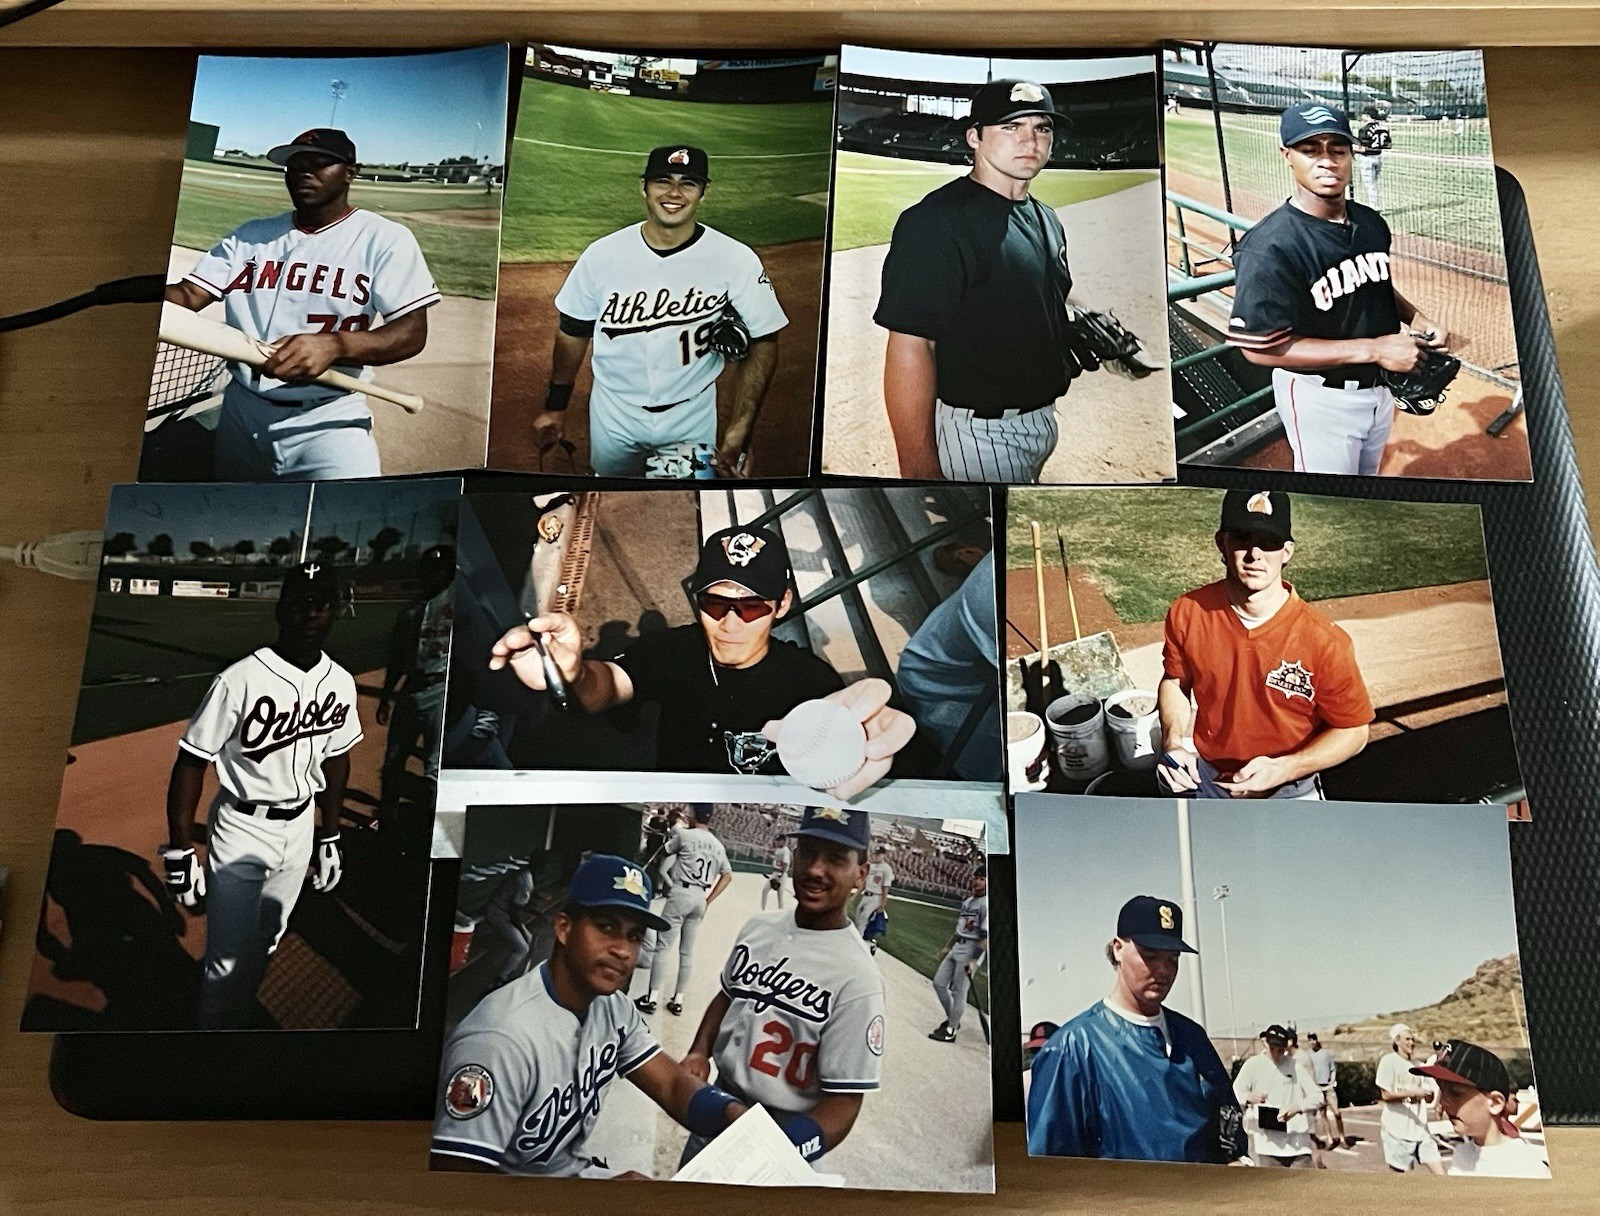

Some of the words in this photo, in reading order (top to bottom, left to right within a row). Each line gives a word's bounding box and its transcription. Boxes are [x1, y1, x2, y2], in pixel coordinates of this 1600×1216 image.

[222, 255, 371, 306] ANGELS
[240, 690, 351, 749] Orioles
[691, 857, 712, 882] 31
[730, 944, 832, 1014] Dodgers
[749, 1020, 819, 1090] 20
